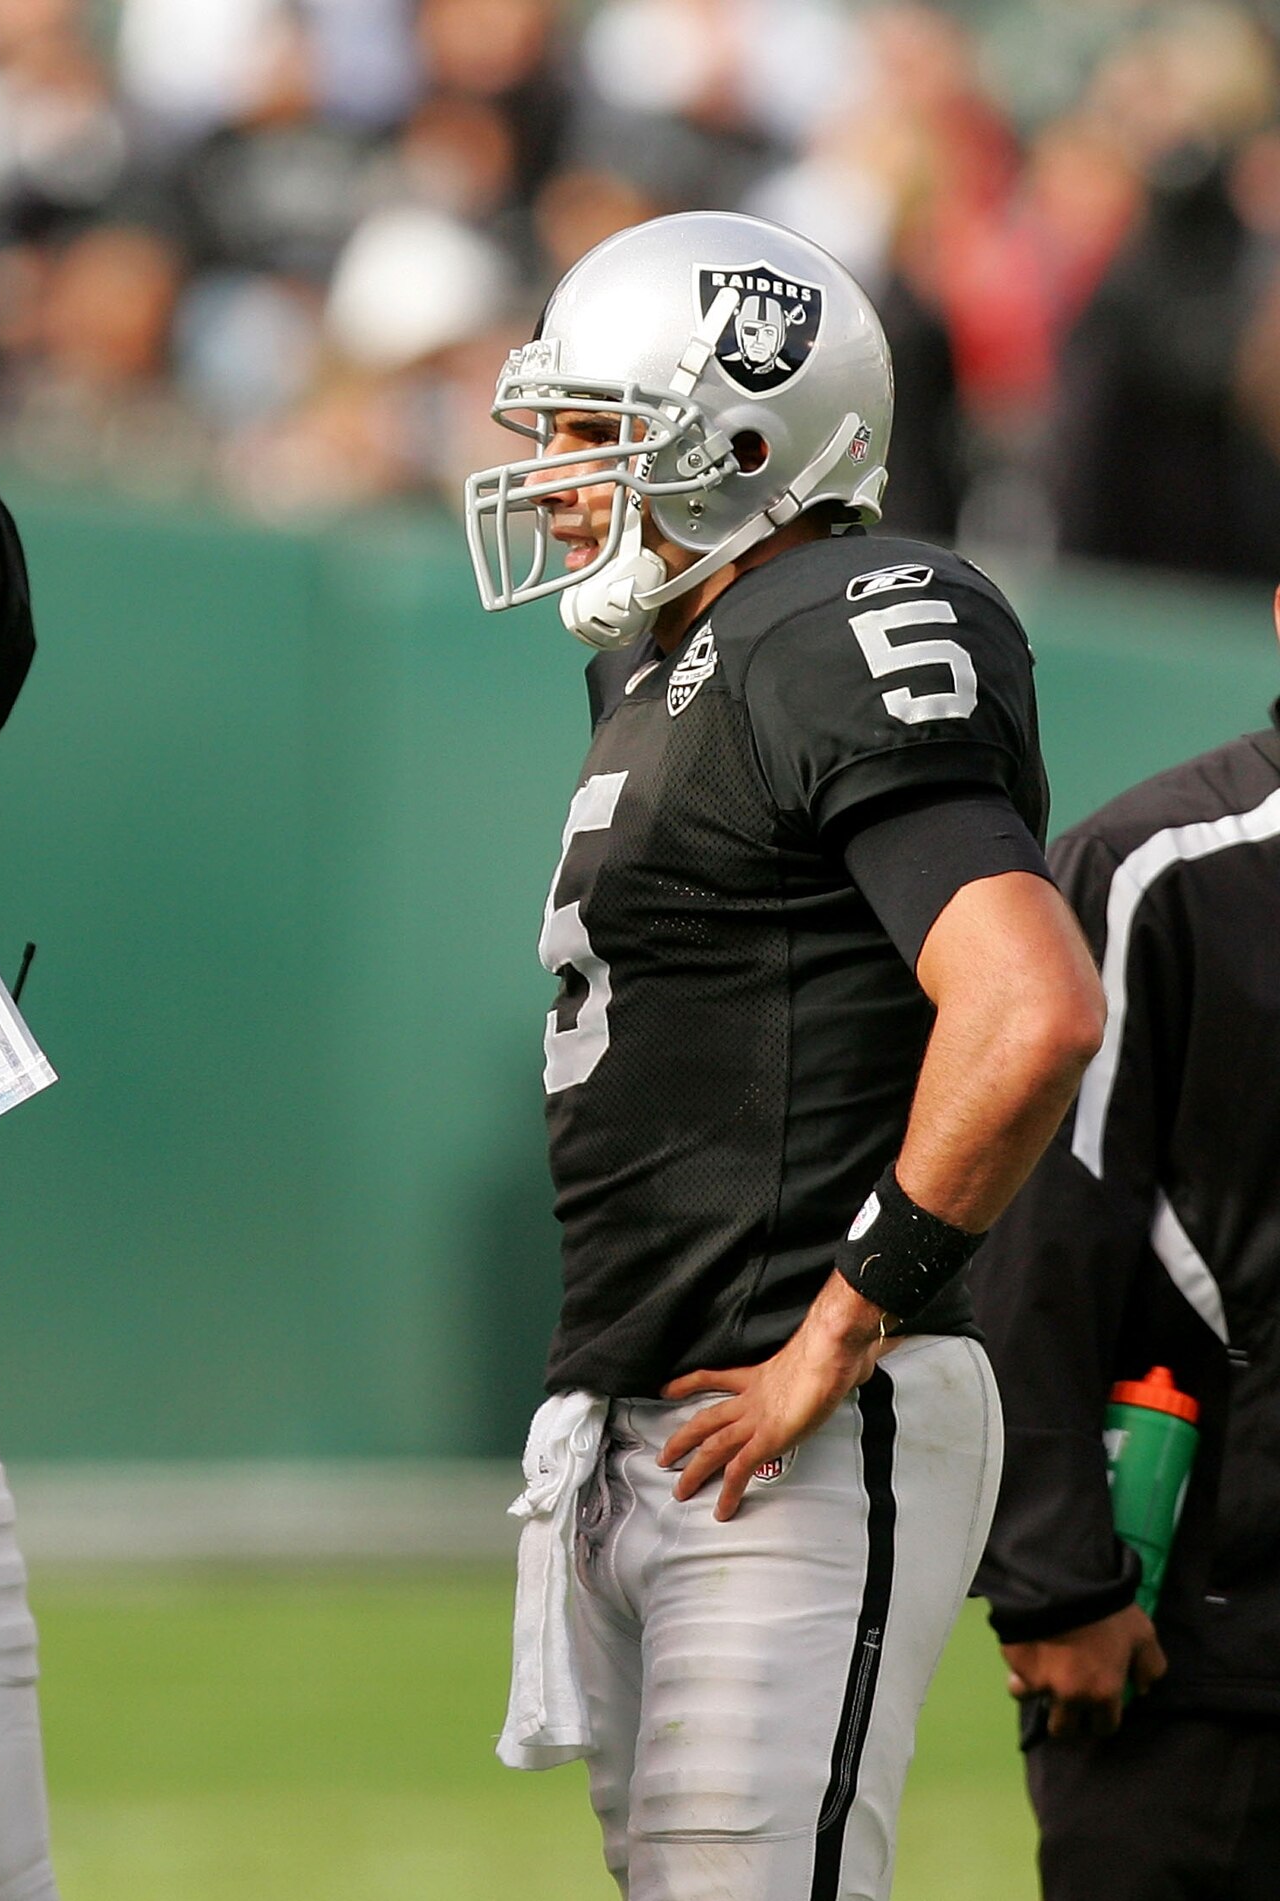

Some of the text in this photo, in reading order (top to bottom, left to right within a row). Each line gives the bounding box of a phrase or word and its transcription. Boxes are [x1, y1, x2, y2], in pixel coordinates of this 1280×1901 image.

[711, 272, 812, 302] RAIDERS
[848, 600, 978, 725] 5
[538, 770, 629, 1095] 5
